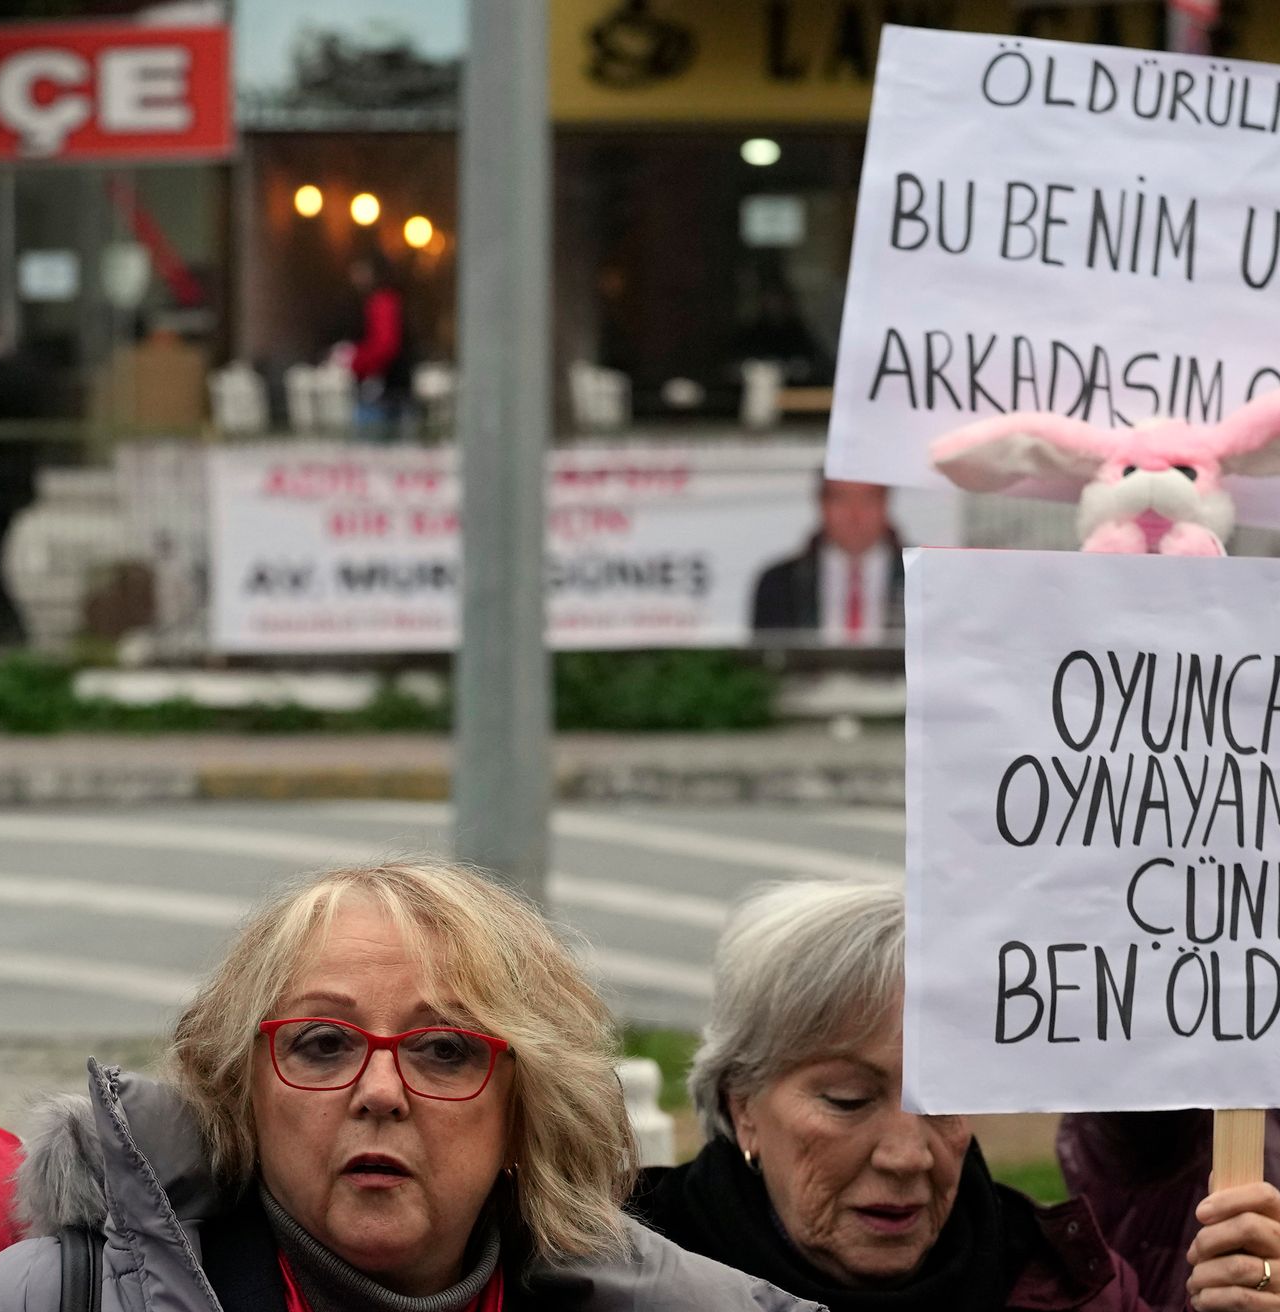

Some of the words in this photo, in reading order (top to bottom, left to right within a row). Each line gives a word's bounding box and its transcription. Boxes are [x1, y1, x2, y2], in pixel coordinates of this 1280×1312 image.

[890, 173, 974, 255] BU
[1001, 176, 1197, 283] BENİM
[994, 940, 1138, 1045] BEN
